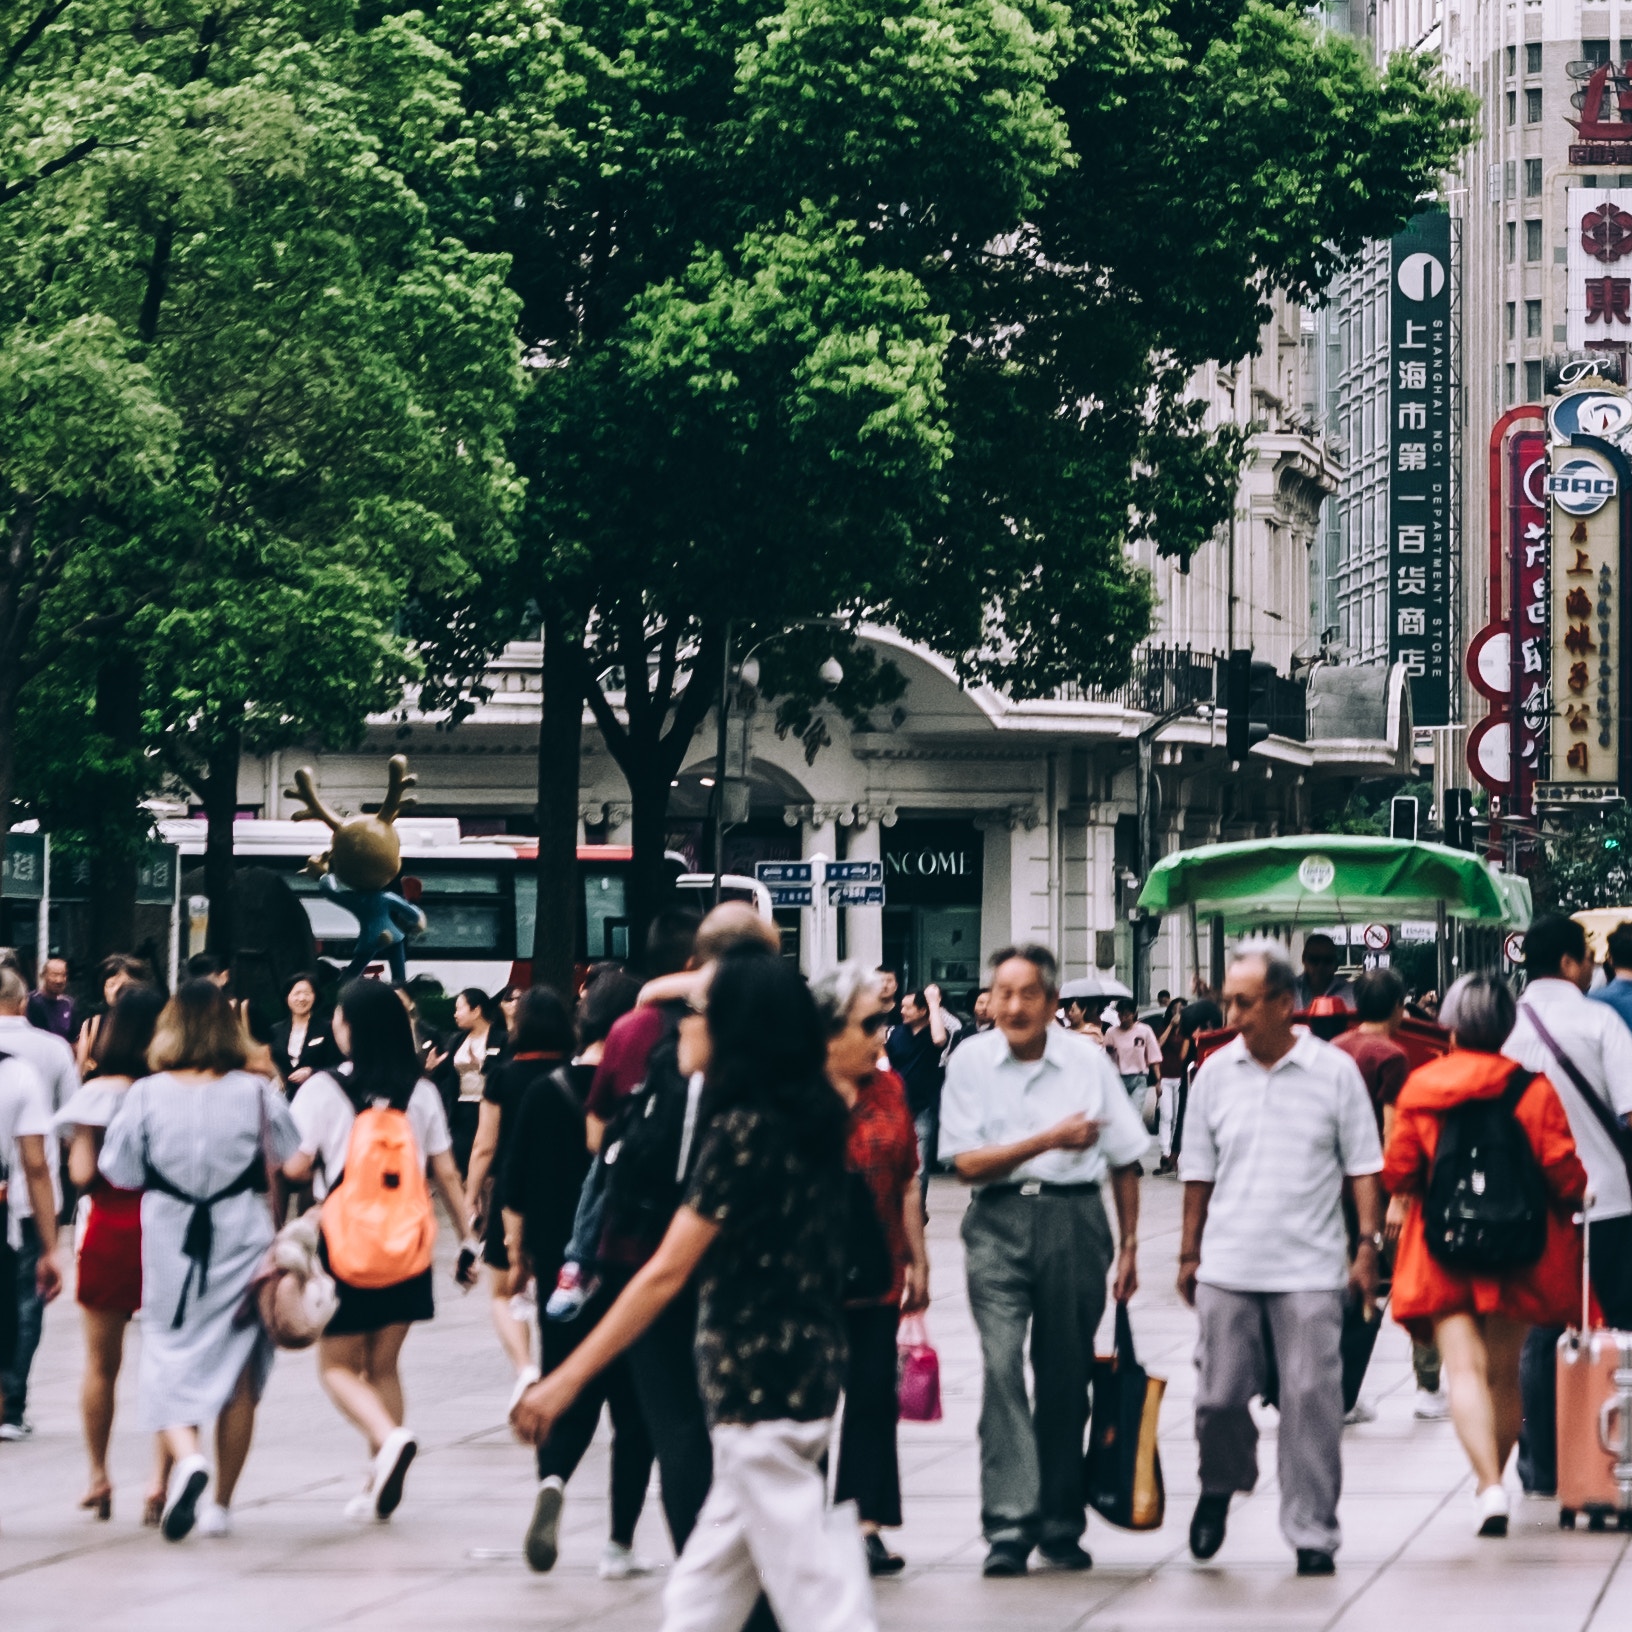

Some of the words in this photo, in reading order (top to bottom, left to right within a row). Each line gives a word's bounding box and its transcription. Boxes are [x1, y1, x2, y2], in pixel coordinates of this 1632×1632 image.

[1432, 320, 1443, 416] SHANGHAI
[1432, 430, 1443, 467] NO.1
[1549, 476, 1615, 494] BAC
[1397, 319, 1427, 678] 上海市第一百货商店
[1431, 484, 1442, 604] DEPARTMENT
[1431, 618, 1442, 678] STORE
